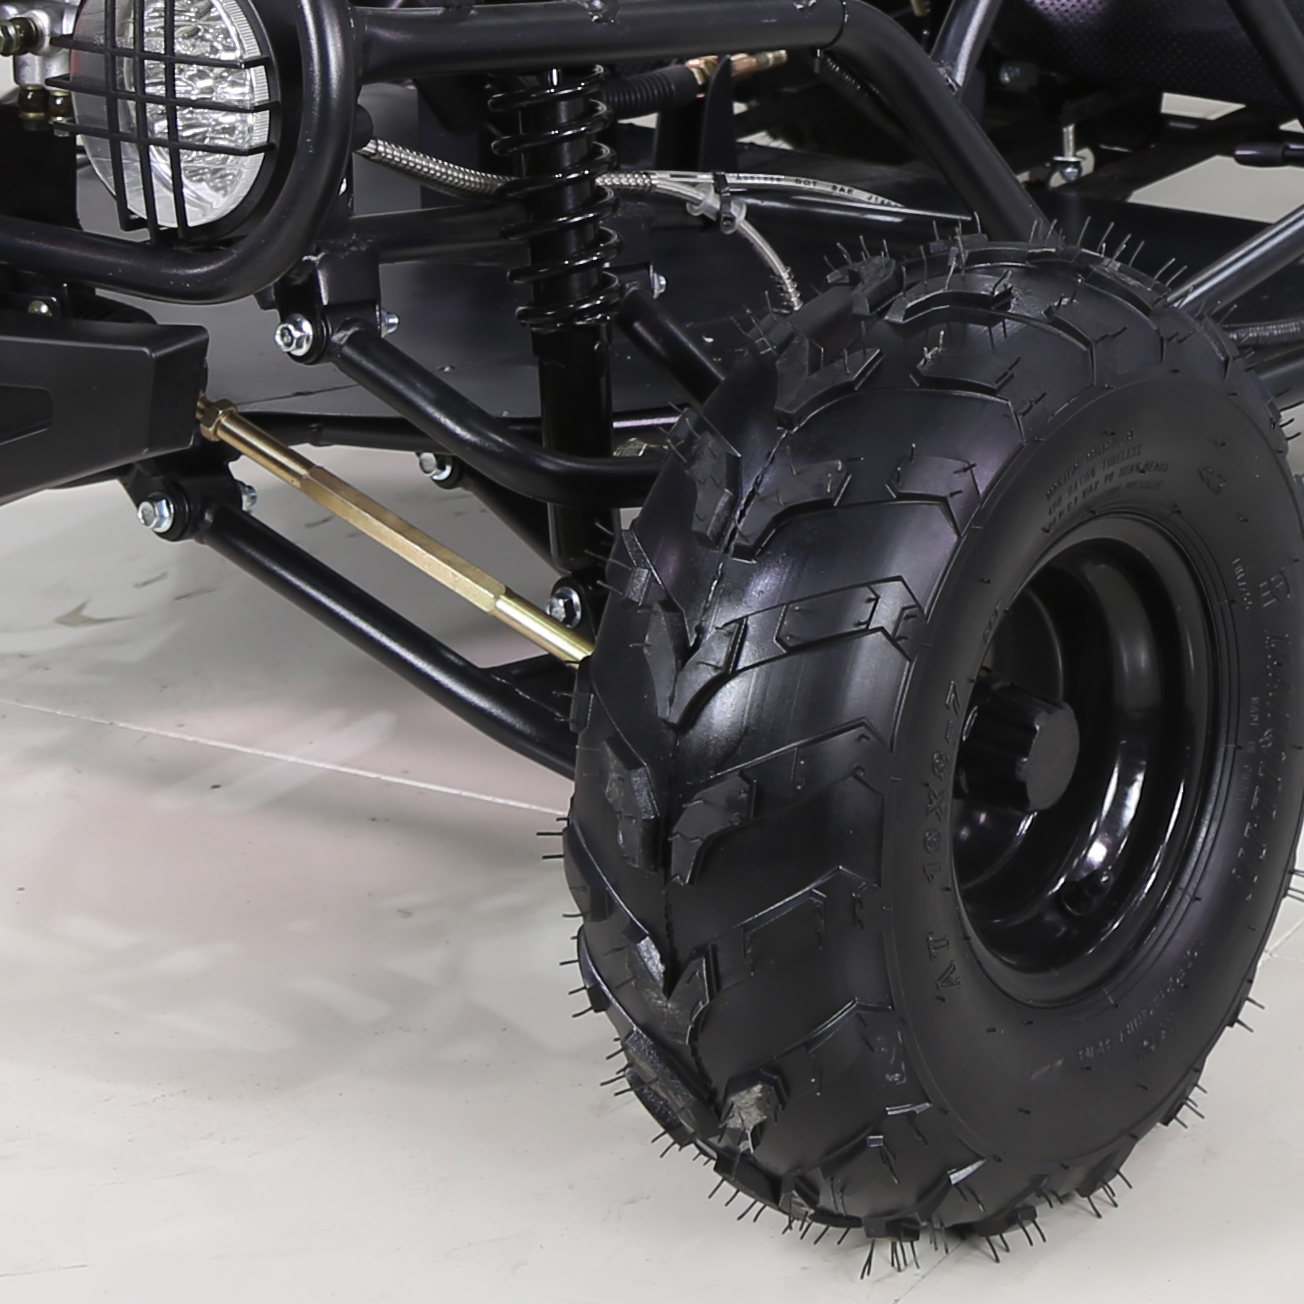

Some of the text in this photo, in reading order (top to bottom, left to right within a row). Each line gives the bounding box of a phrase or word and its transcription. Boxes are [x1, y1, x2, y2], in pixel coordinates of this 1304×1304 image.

[795, 177, 818, 188] DOT
[831, 184, 854, 195] SAE
[1102, 444, 1143, 471] TUBELESS
[922, 679, 962, 991] AT 16X8-7
